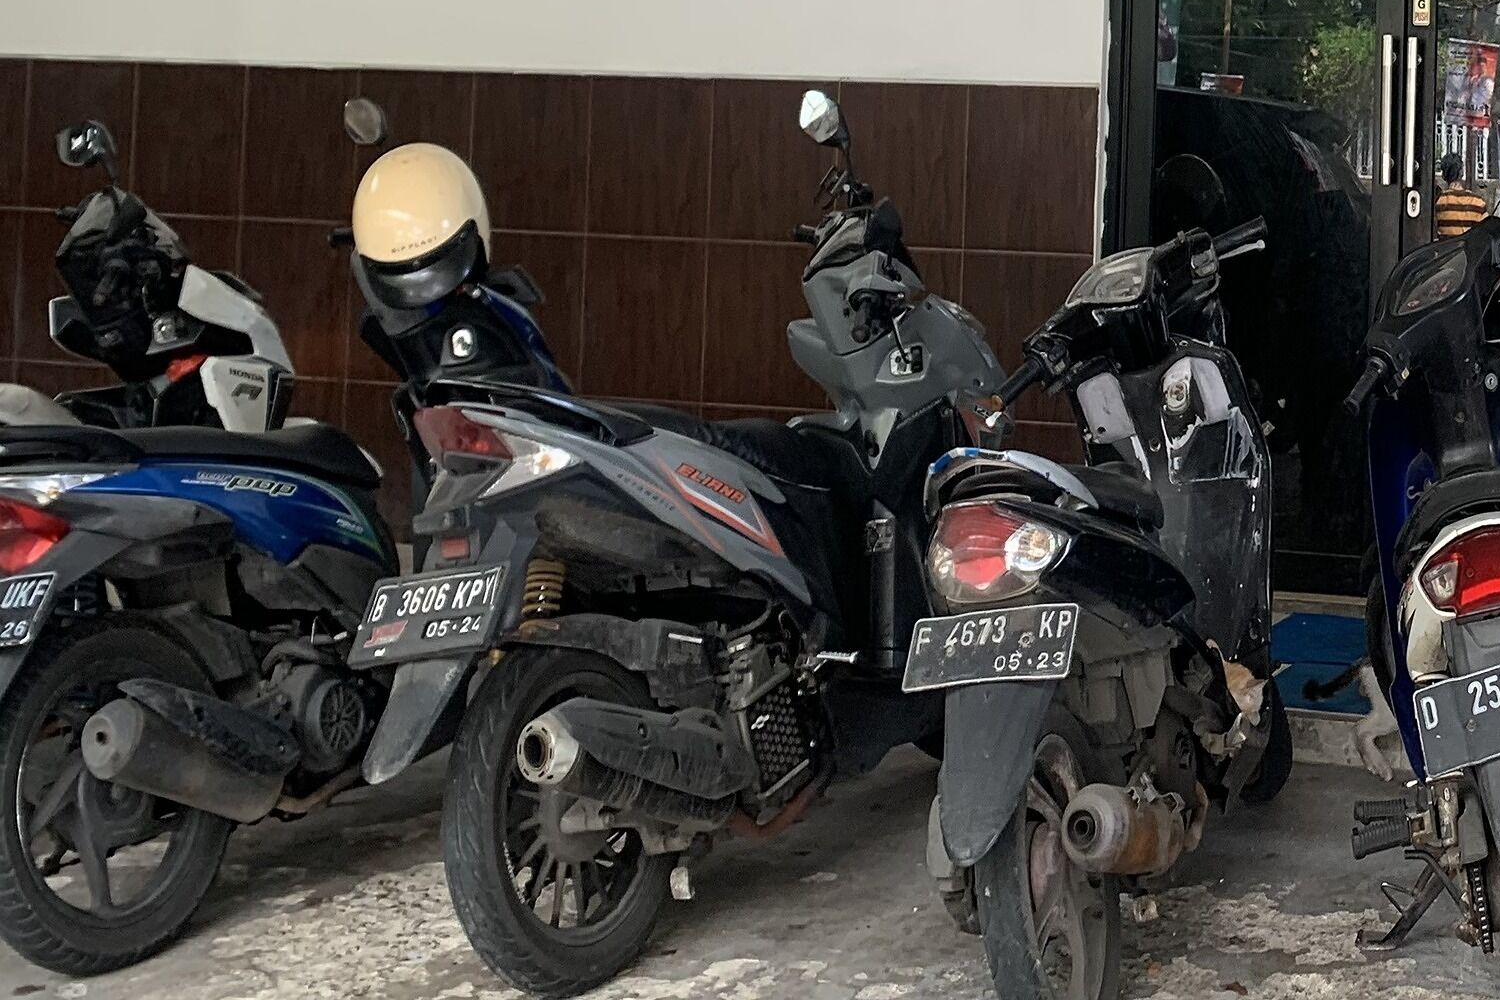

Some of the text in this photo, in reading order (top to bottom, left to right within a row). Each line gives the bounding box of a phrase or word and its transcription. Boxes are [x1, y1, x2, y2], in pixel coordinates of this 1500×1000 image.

[1413, 11, 1429, 22] PUSH
[229, 367, 265, 383] HONDA
[0, 578, 49, 609] UKF
[371, 574, 495, 623] B 3606 KPY
[0, 619, 28, 639] 26
[915, 609, 1073, 656] F 4673 KP
[1419, 695, 1439, 732] D
